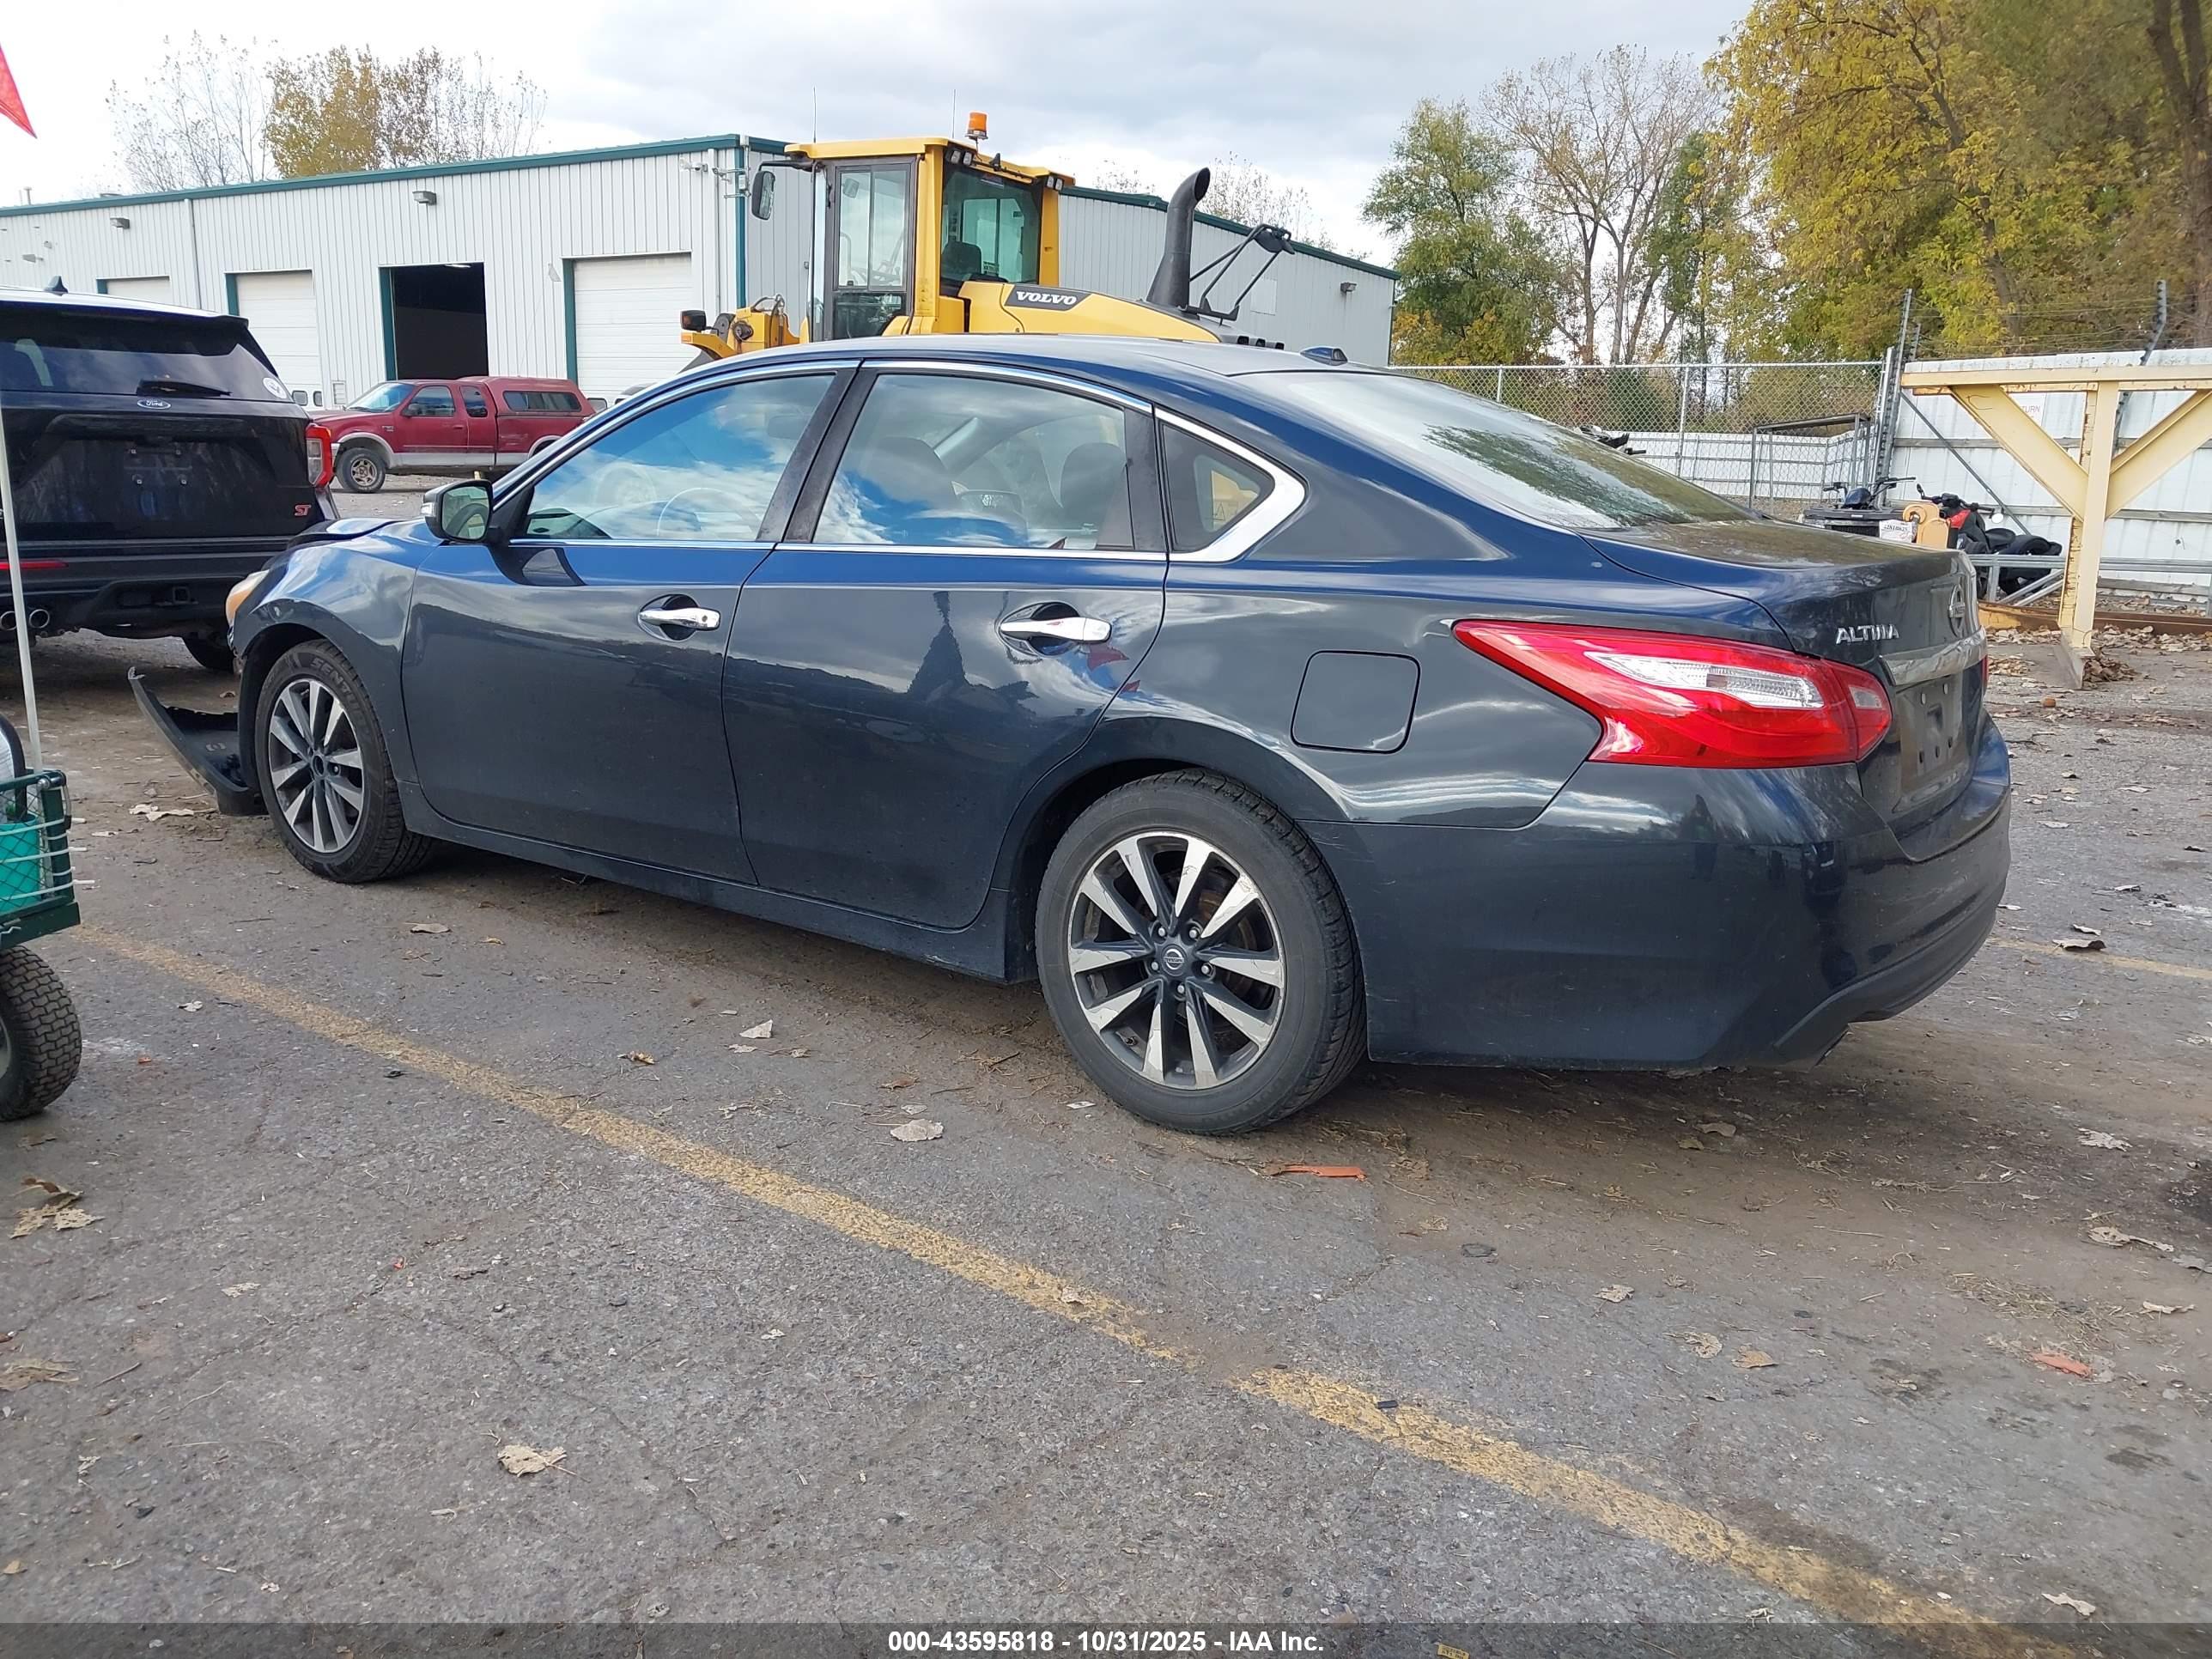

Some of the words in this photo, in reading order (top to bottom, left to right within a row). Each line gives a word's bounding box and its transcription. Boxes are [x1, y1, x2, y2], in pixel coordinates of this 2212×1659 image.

[1017, 291, 1077, 306] VOLVO
[295, 505, 312, 516] ST
[1836, 623, 1899, 645] ALTIMA
